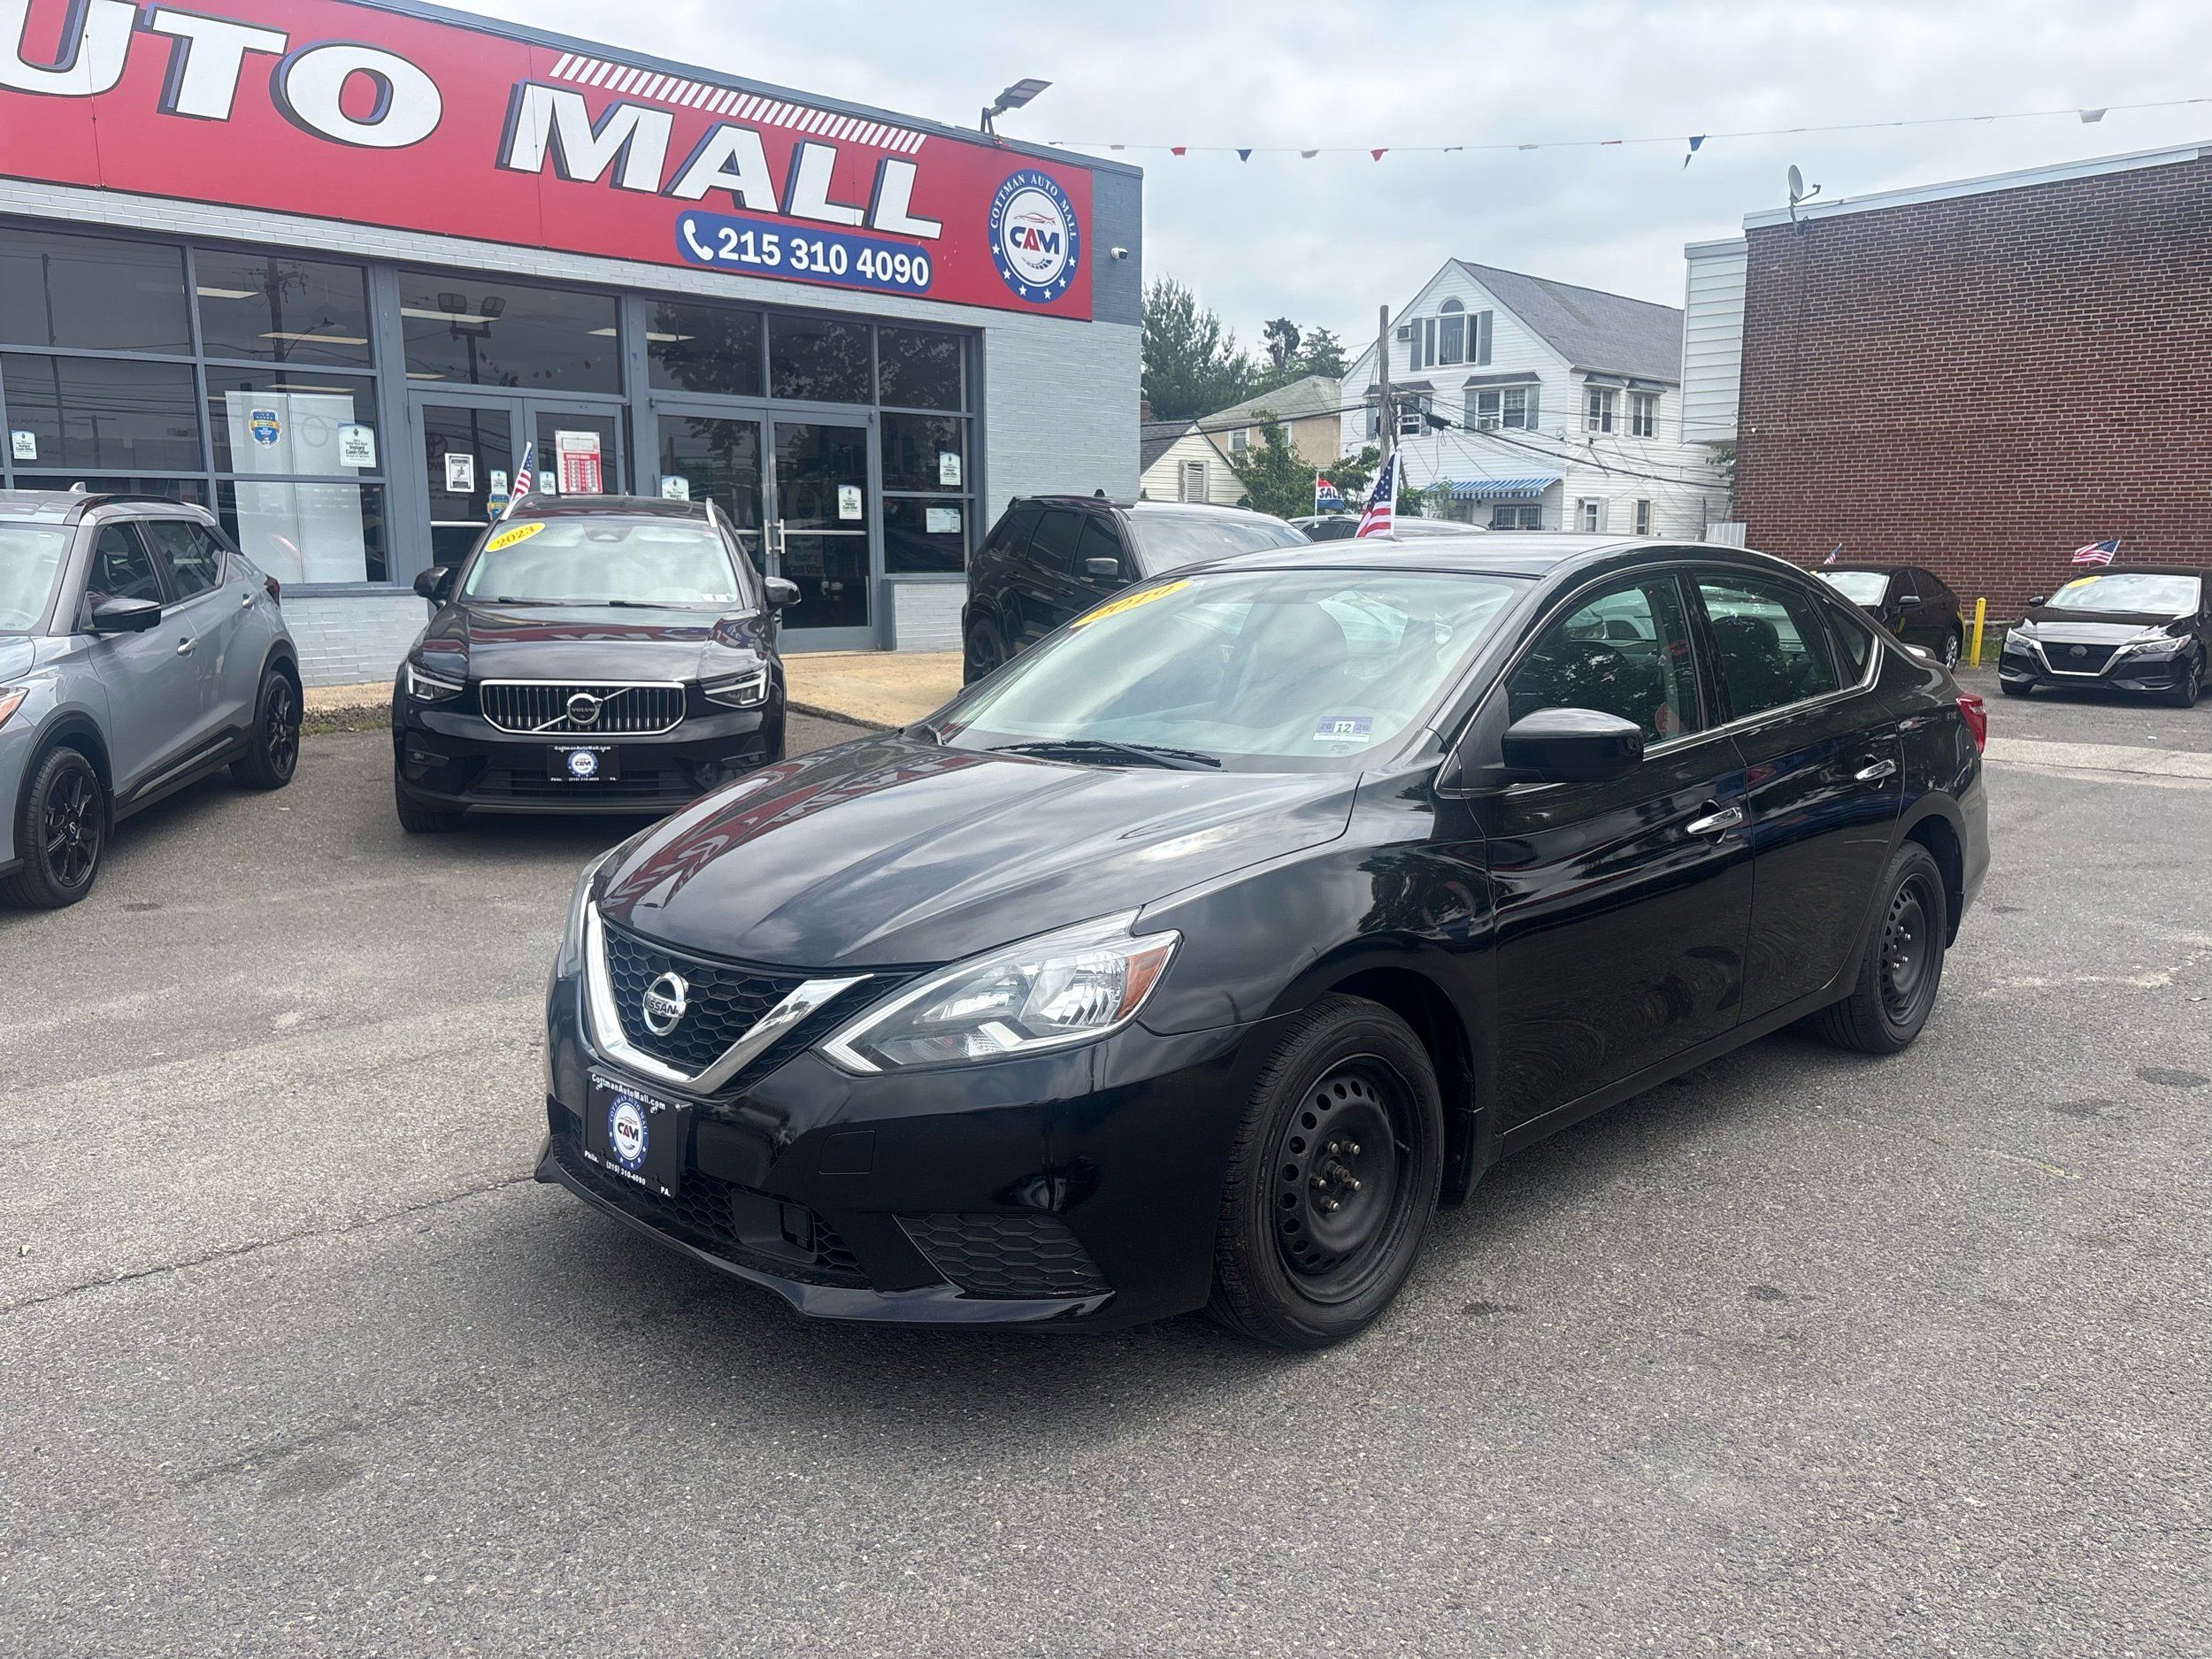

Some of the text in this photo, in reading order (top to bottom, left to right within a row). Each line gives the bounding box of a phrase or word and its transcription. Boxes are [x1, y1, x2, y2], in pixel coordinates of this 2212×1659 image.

[499, 81, 944, 241] MALL
[990, 173, 1077, 241] COTTMAN AUTO MALL
[718, 227, 929, 287] 215 310 4090
[1010, 226, 1060, 256] CAM
[496, 526, 534, 548] 2023
[1336, 723, 1352, 733] 12
[592, 1073, 666, 1110] CottmanAutoMall.com
[618, 1122, 640, 1141] CAM
[606, 1160, 620, 1173] (215)
[660, 1186, 671, 1197] PA.
